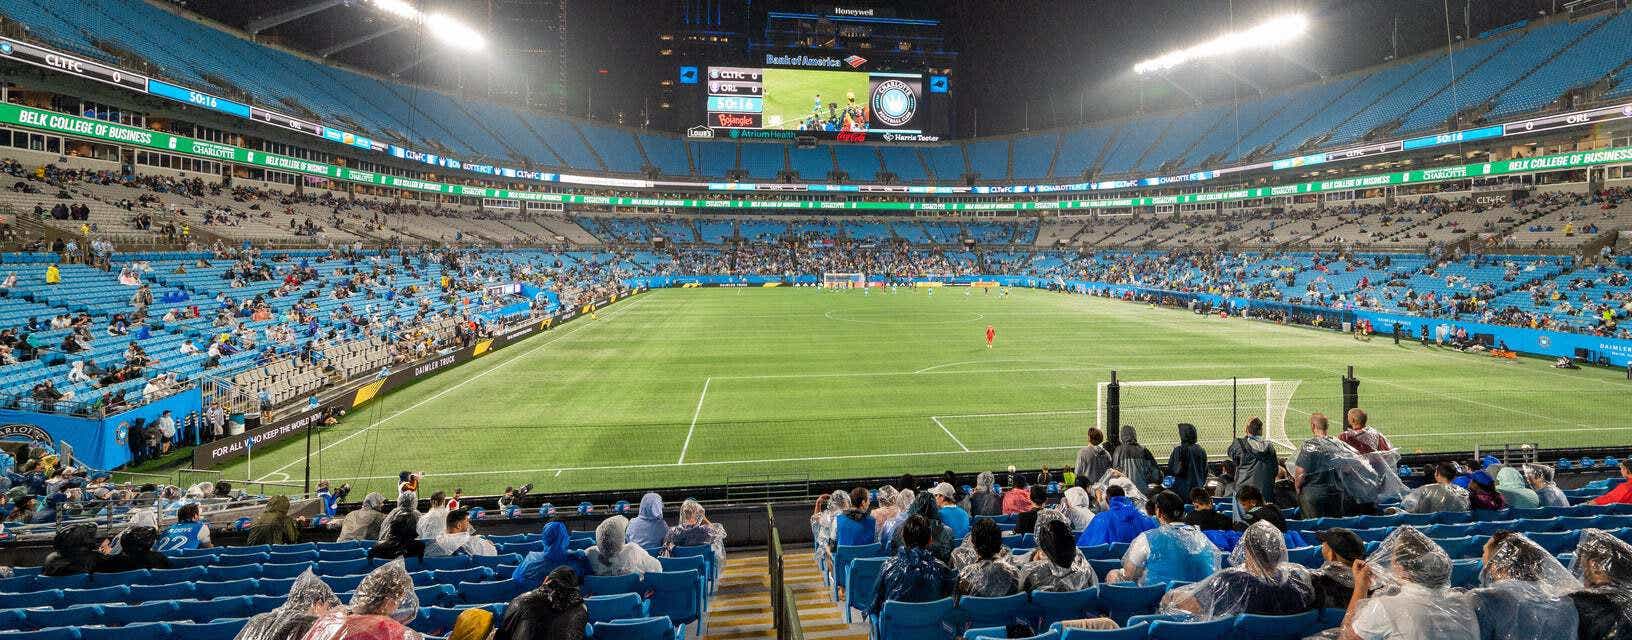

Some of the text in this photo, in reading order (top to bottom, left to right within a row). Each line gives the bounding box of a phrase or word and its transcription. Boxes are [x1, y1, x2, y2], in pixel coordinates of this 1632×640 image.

[835, 7, 874, 17] Honeywell
[45, 53, 122, 83] CLTFC 0
[766, 54, 841, 68] Bank of America
[721, 71, 757, 80] CLTFC 0
[721, 84, 757, 93] ORL 0
[189, 91, 217, 108] 50:16
[19, 110, 152, 144] BELK COLLEGE OF BUSINESS
[719, 114, 753, 127] Bojangles
[1525, 113, 1590, 131] 0 ORL
[741, 129, 770, 138] Atrium
[192, 144, 234, 159] CHARLOTTE
[1508, 149, 1632, 171] BELK COLLEGE OF BUSINESS
[1423, 170, 1466, 180] CHARLOTTE
[415, 362, 439, 377] DAIMLER
[212, 445, 228, 459] FOR
[229, 441, 243, 453] ALL
[262, 428, 279, 441] KEEP
[279, 425, 291, 436] THE
[291, 417, 310, 430] WORLD
